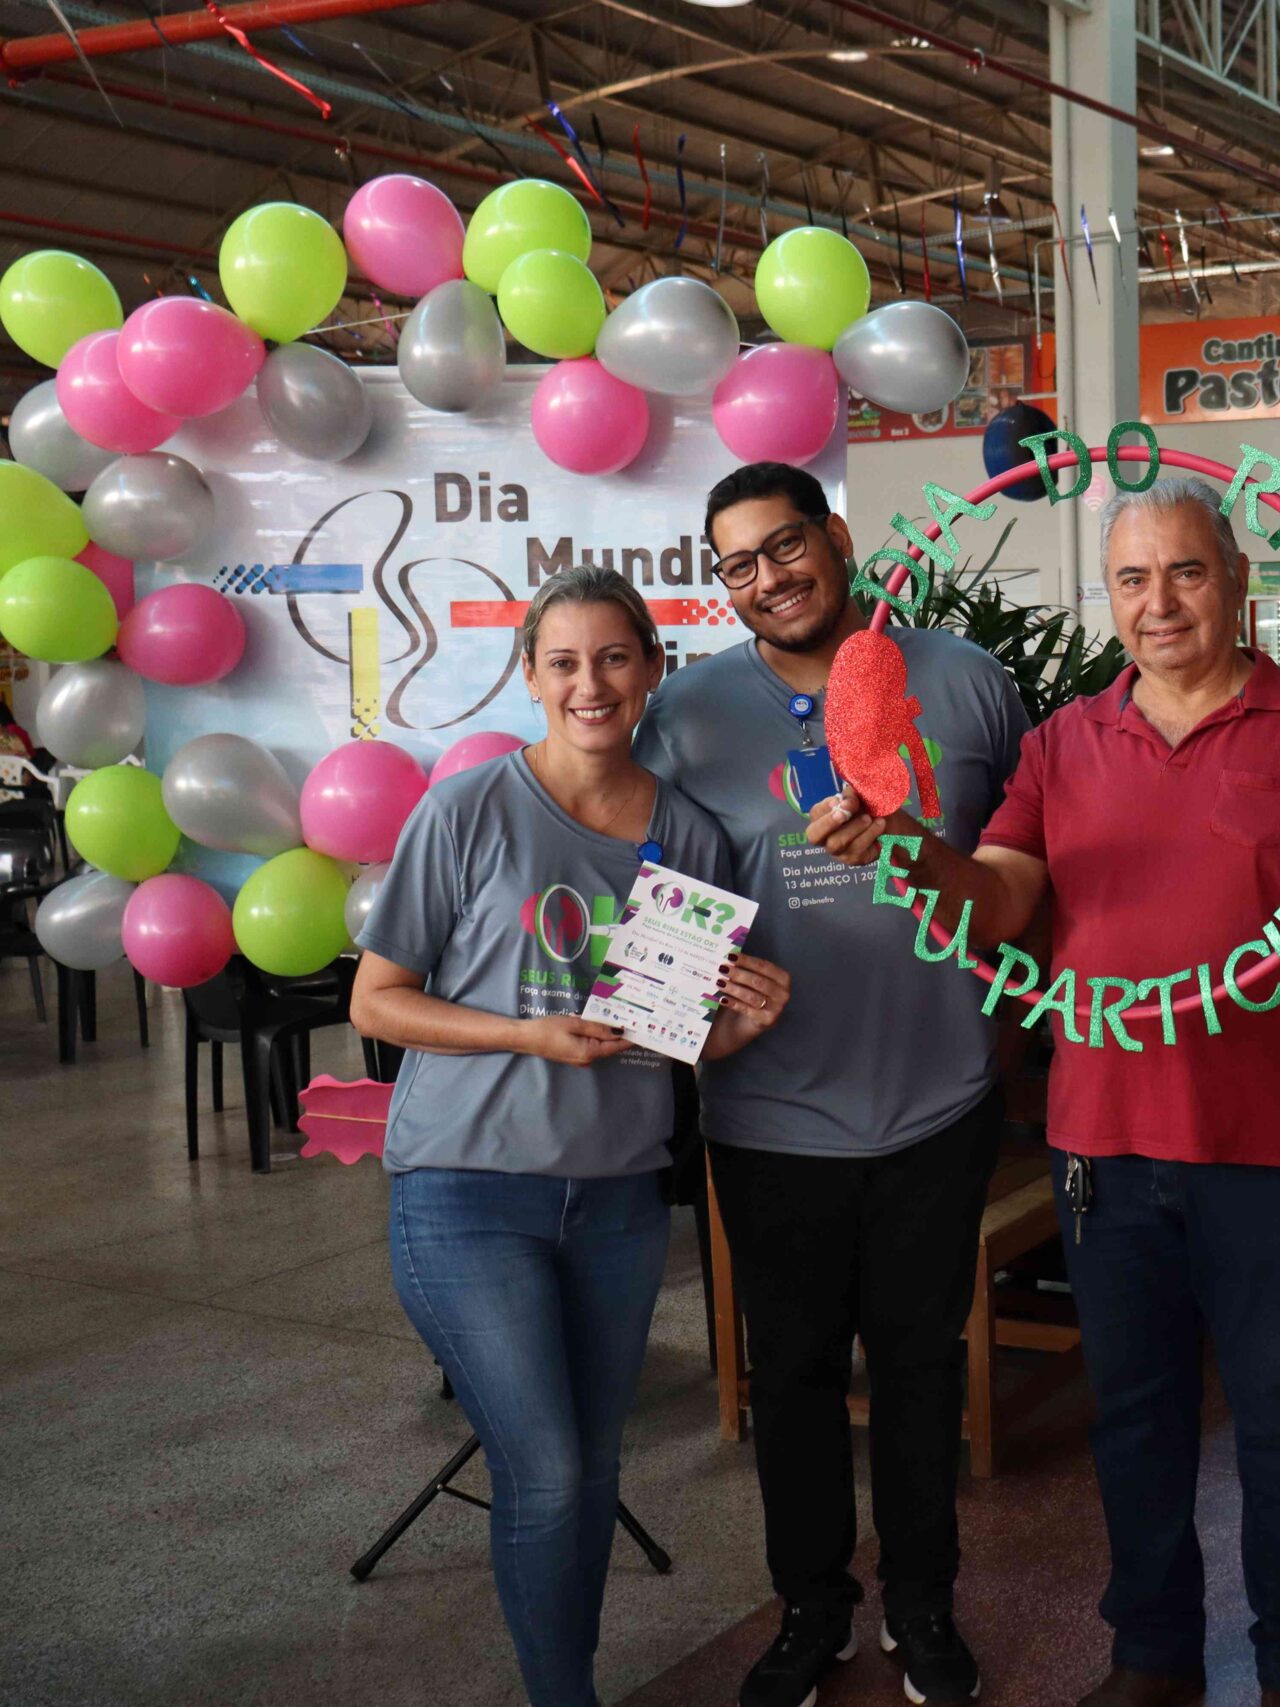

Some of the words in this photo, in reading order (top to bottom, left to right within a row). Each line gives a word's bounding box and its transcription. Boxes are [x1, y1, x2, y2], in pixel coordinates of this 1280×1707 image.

[433, 471, 530, 523] Dia
[850, 481, 998, 615] DIA
[1018, 420, 1161, 506] DO
[526, 534, 713, 587] Mundi
[778, 832, 808, 848] SEU
[780, 849, 802, 859] Faça
[782, 867, 801, 877] Dia
[803, 861, 845, 875] Mundial
[785, 880, 797, 890] 13
[800, 878, 811, 888] de
[814, 874, 850, 887] MARÇO
[861, 870, 877, 881] 202
[872, 833, 978, 969] EU
[521, 969, 556, 985] SEUS
[541, 989, 572, 999] exame
[520, 1003, 535, 1014] Dia
